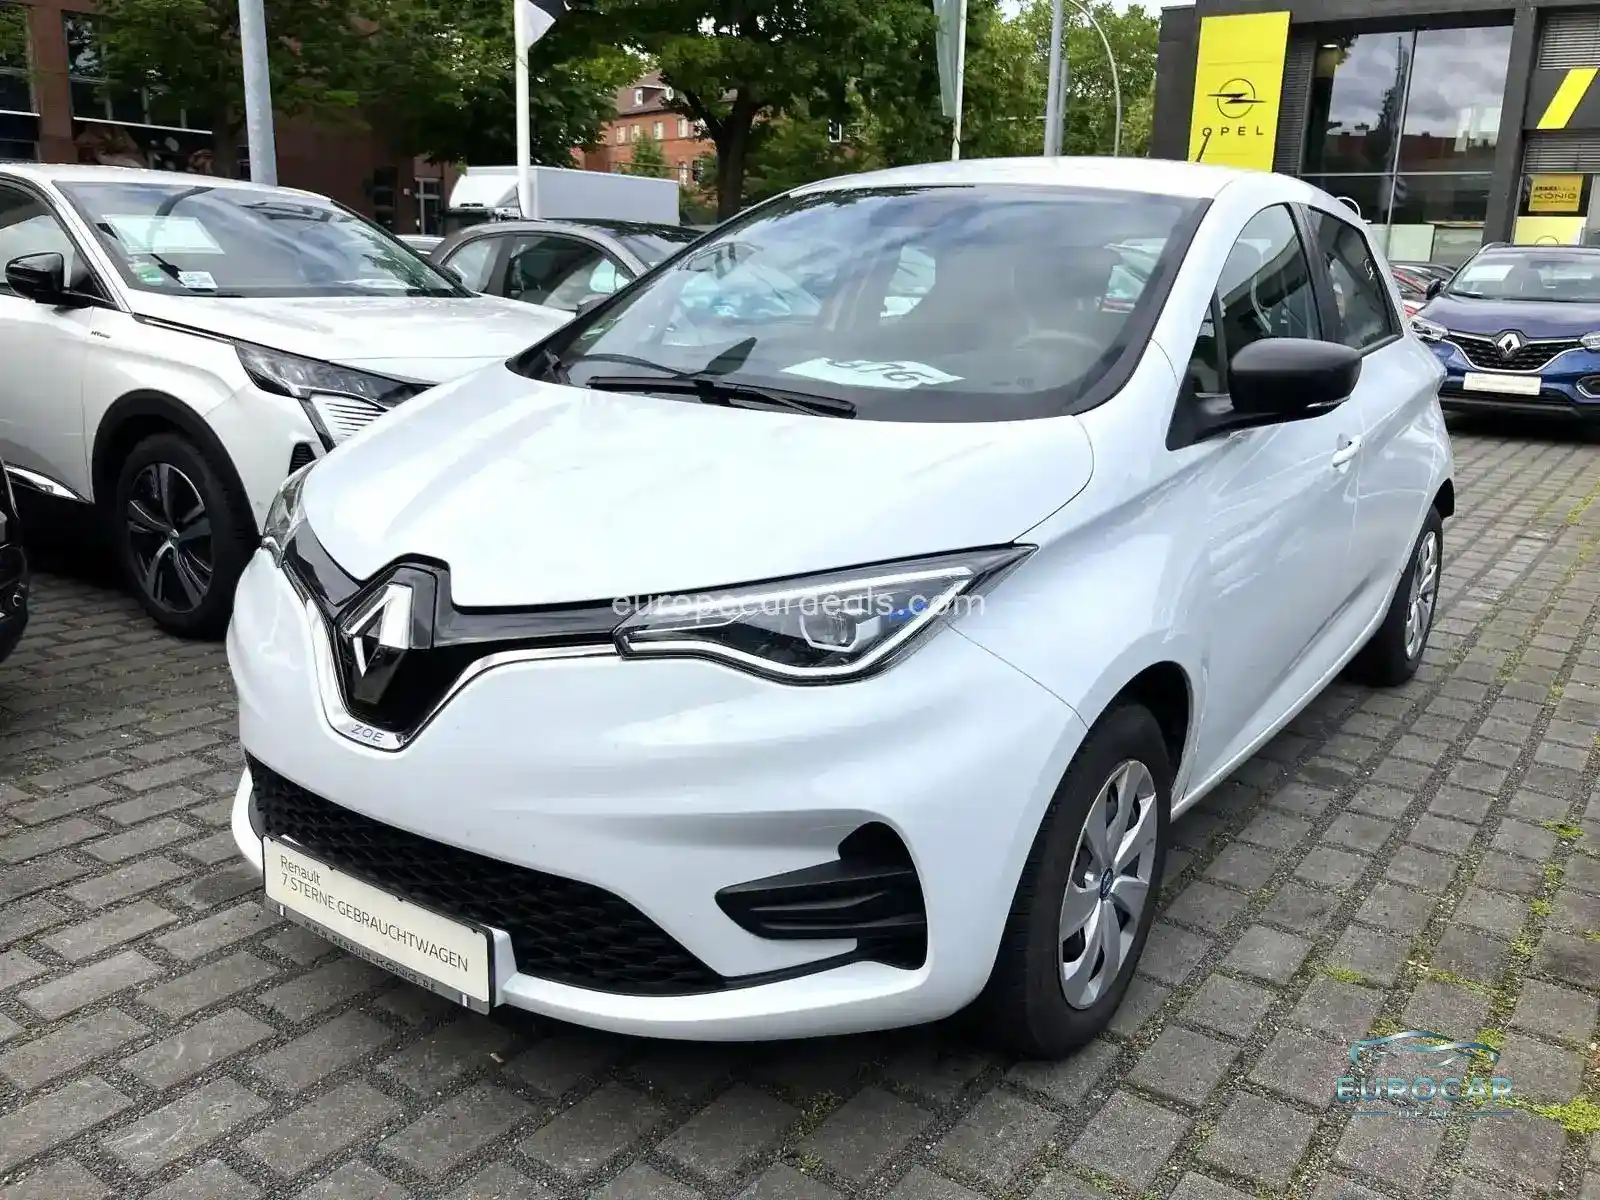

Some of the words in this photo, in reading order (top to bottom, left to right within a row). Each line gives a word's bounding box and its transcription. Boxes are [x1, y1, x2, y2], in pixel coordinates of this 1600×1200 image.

[1202, 125, 1264, 136] OPEL
[351, 724, 385, 742] ZOE
[280, 855, 321, 886] Renault
[281, 873, 289, 887] 7
[291, 877, 336, 911] STERNE
[337, 900, 469, 973] GEBRAUCHTWAGEN
